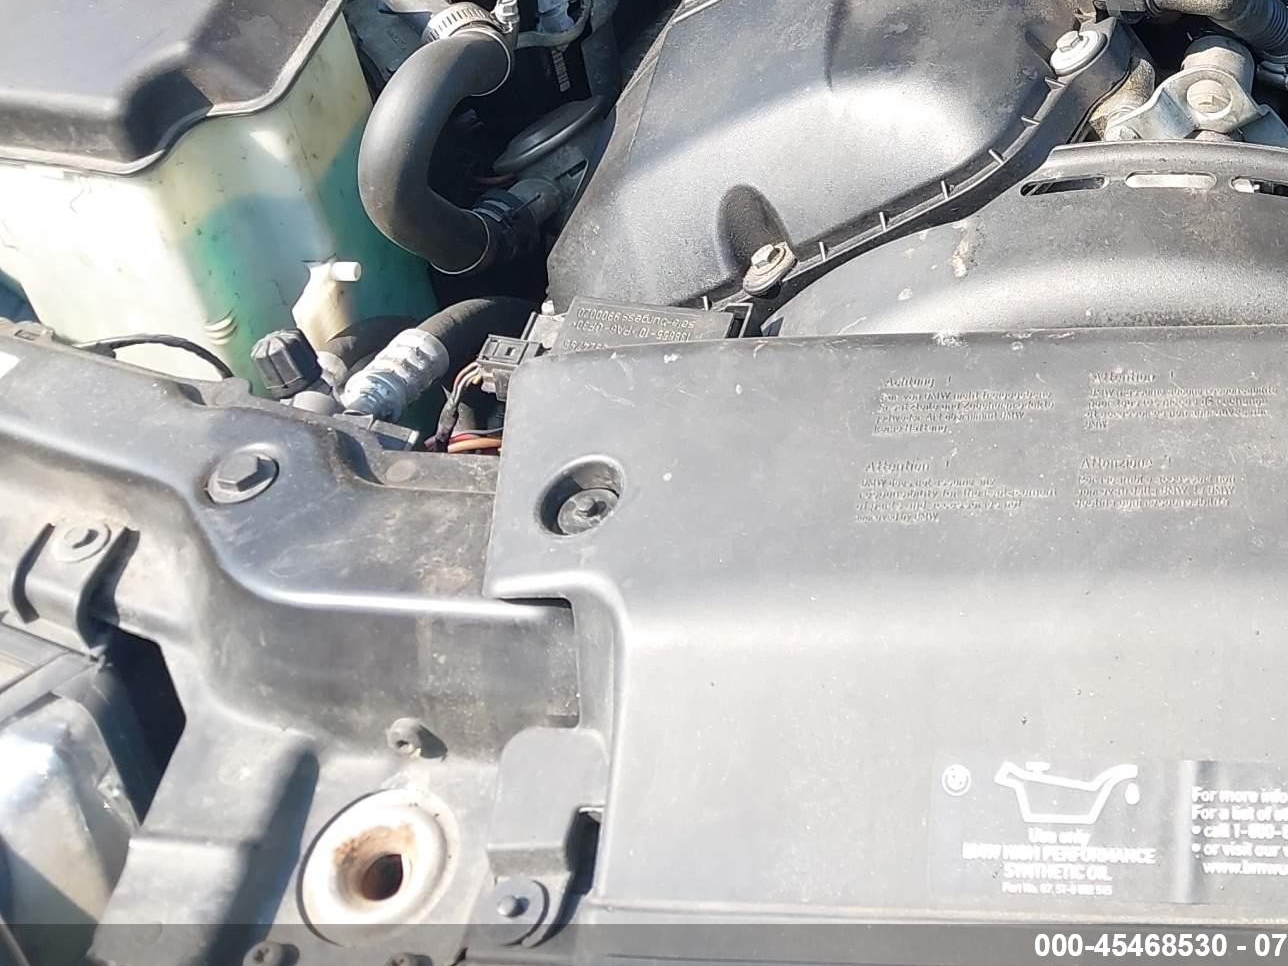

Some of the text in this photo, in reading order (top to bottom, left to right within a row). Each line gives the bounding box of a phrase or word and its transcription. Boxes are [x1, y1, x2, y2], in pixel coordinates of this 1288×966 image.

[1192, 787, 1217, 803] For
[1219, 790, 1258, 803] more
[1261, 788, 1288, 804] info
[1192, 805, 1217, 820] For
[1218, 808, 1229, 820] a
[1232, 805, 1254, 821] list
[1256, 805, 1272, 821] of
[1059, 829, 1091, 846] only
[1203, 823, 1230, 838] call
[1042, 845, 1156, 864] PERFORMANCE
[1203, 843, 1221, 856] or
[1222, 842, 1252, 857] visit
[1255, 845, 1281, 857] our
[1003, 862, 1113, 881] SYNTHETIC OIL
